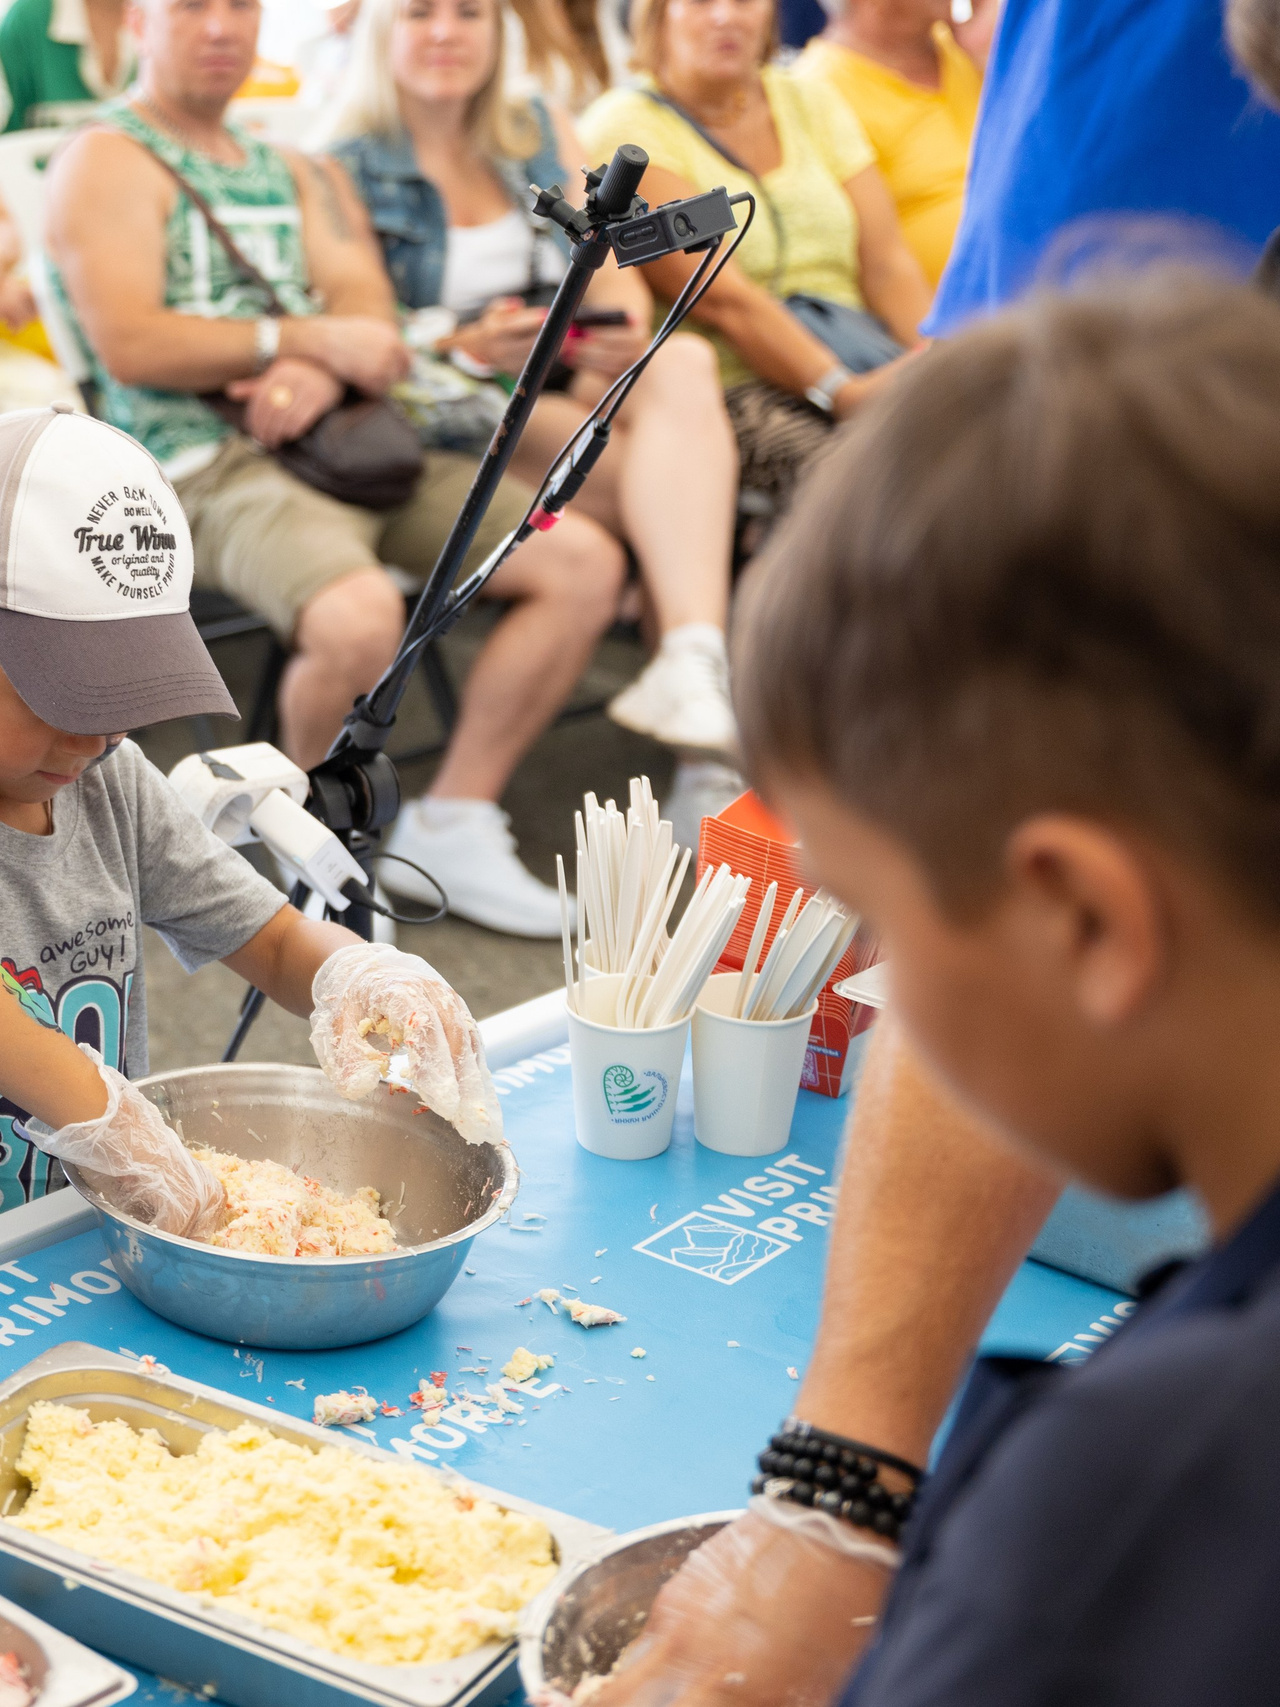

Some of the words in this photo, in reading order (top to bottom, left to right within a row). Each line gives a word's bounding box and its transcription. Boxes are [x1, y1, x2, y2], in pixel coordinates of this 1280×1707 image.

[86, 490, 119, 525] NEVER
[123, 506, 135, 517] DO
[135, 506, 152, 517] WELL
[73, 526, 125, 554] True
[90, 555, 117, 588] MAKE
[116, 581, 164, 600] YOURSELF
[162, 552, 176, 588] PROUD
[111, 553, 150, 570] original
[150, 551, 165, 563] and
[130, 565, 161, 582] quality
[39, 911, 134, 964] awesome
[70, 934, 125, 974] GUY!
[701, 1153, 826, 1218] VISIT
